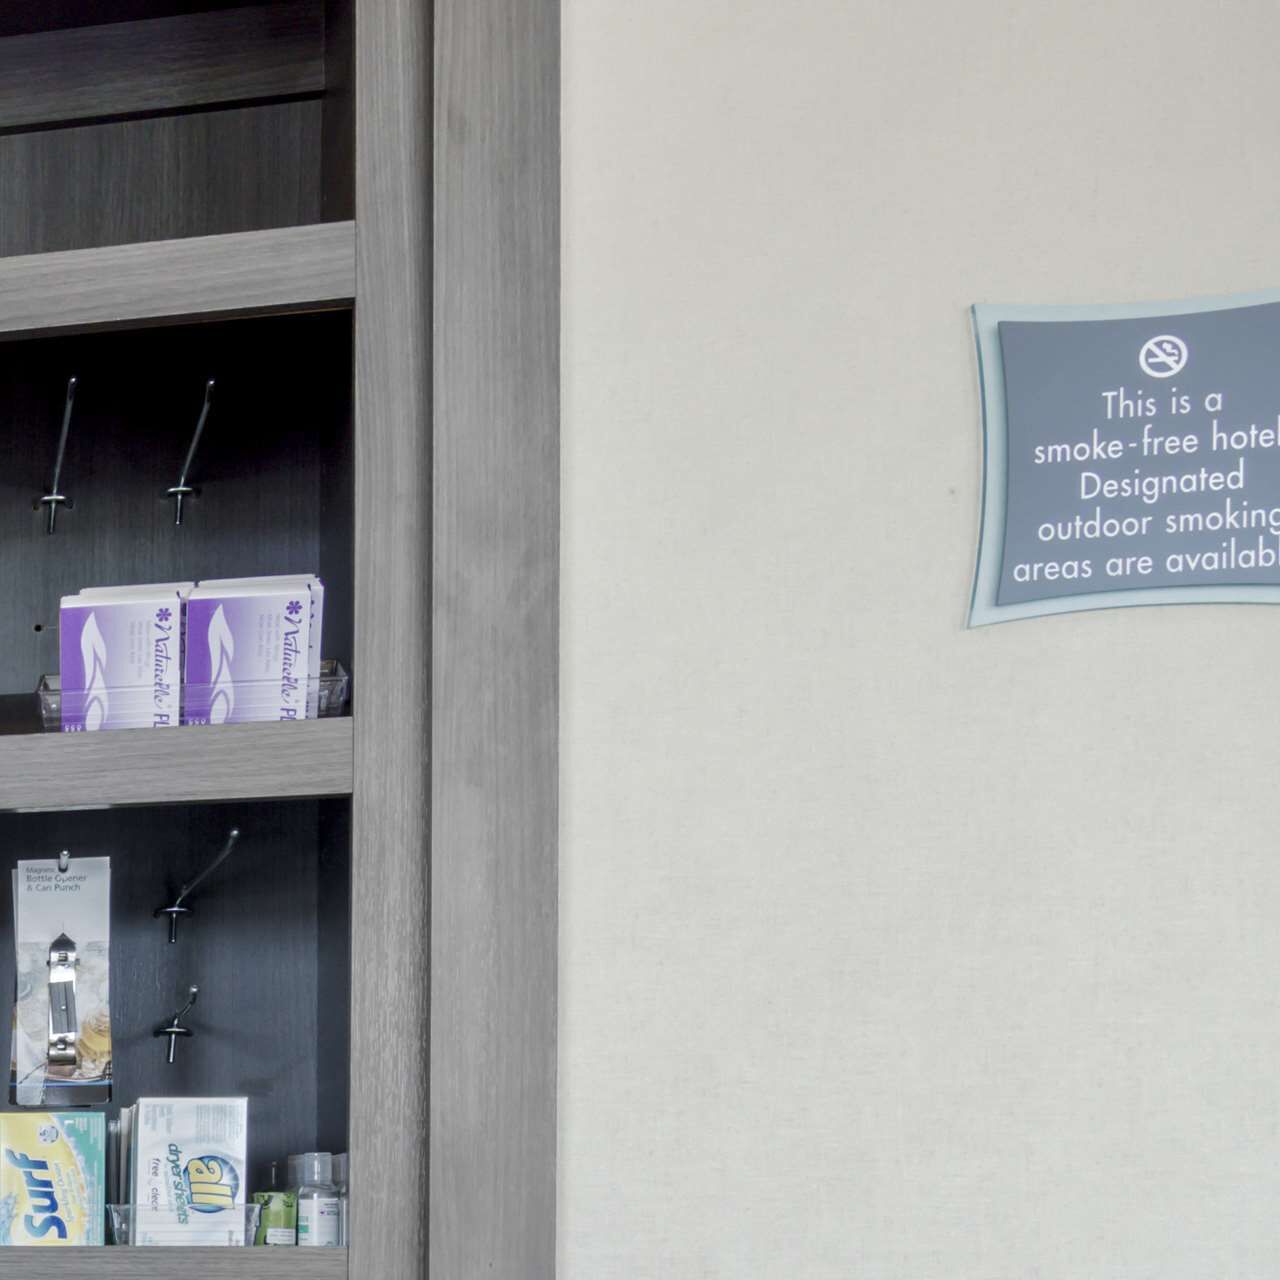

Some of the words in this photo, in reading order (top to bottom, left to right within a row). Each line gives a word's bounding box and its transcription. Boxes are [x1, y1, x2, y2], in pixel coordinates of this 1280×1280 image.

[1102, 387, 1157, 419] This
[1170, 387, 1191, 414] is
[1204, 392, 1223, 412] a
[1034, 424, 1199, 464] smoke-free
[1080, 457, 1245, 504] Designated
[1038, 506, 1152, 541] outdoor
[1013, 557, 1092, 582] areas
[1106, 555, 1153, 576] are
[154, 623, 173, 709] Naturelle
[280, 617, 302, 703] Naturelle
[36, 883, 52, 892] Can
[54, 883, 81, 892] Punch
[55, 875, 87, 884] Opener
[151, 1157, 162, 1177] free
[167, 1143, 183, 1178] dryer
[4, 1147, 68, 1240] Surf
[186, 1158, 235, 1210] all
